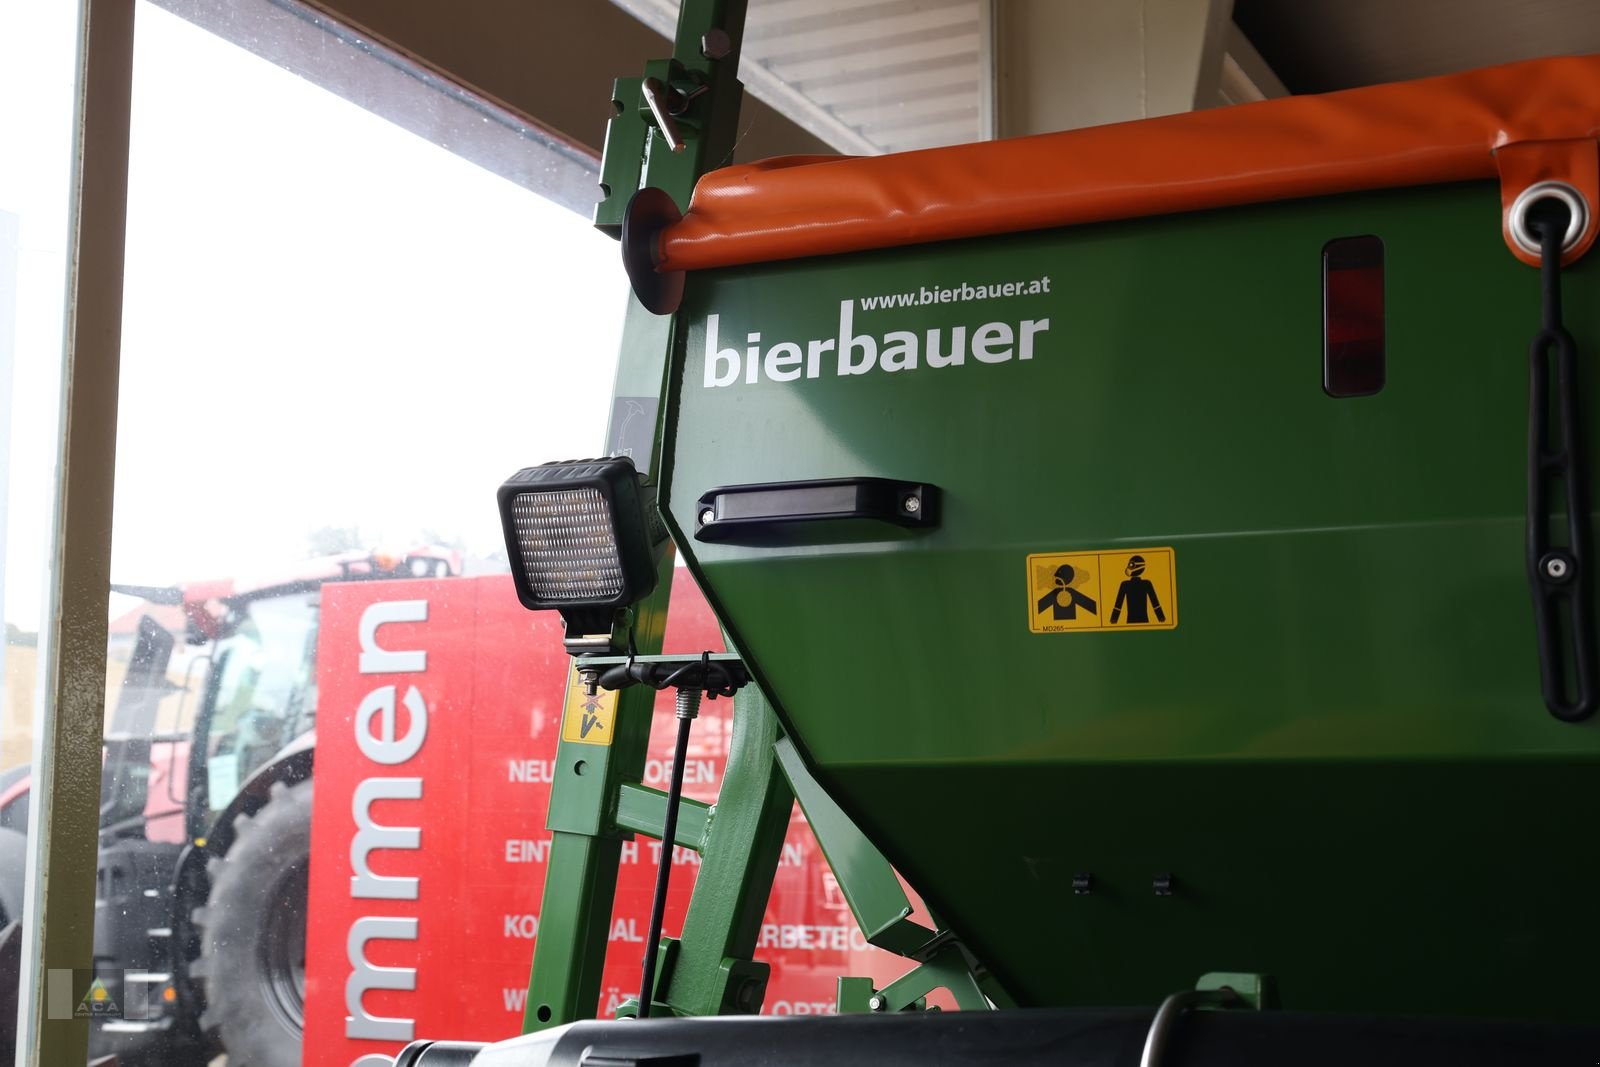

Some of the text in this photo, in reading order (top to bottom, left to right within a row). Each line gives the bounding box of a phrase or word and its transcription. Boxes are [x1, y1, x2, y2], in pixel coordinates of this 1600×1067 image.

[861, 276, 1050, 311] www.bierbauer.at
[703, 299, 1050, 388] bierbauer
[343, 599, 428, 1067] mmen
